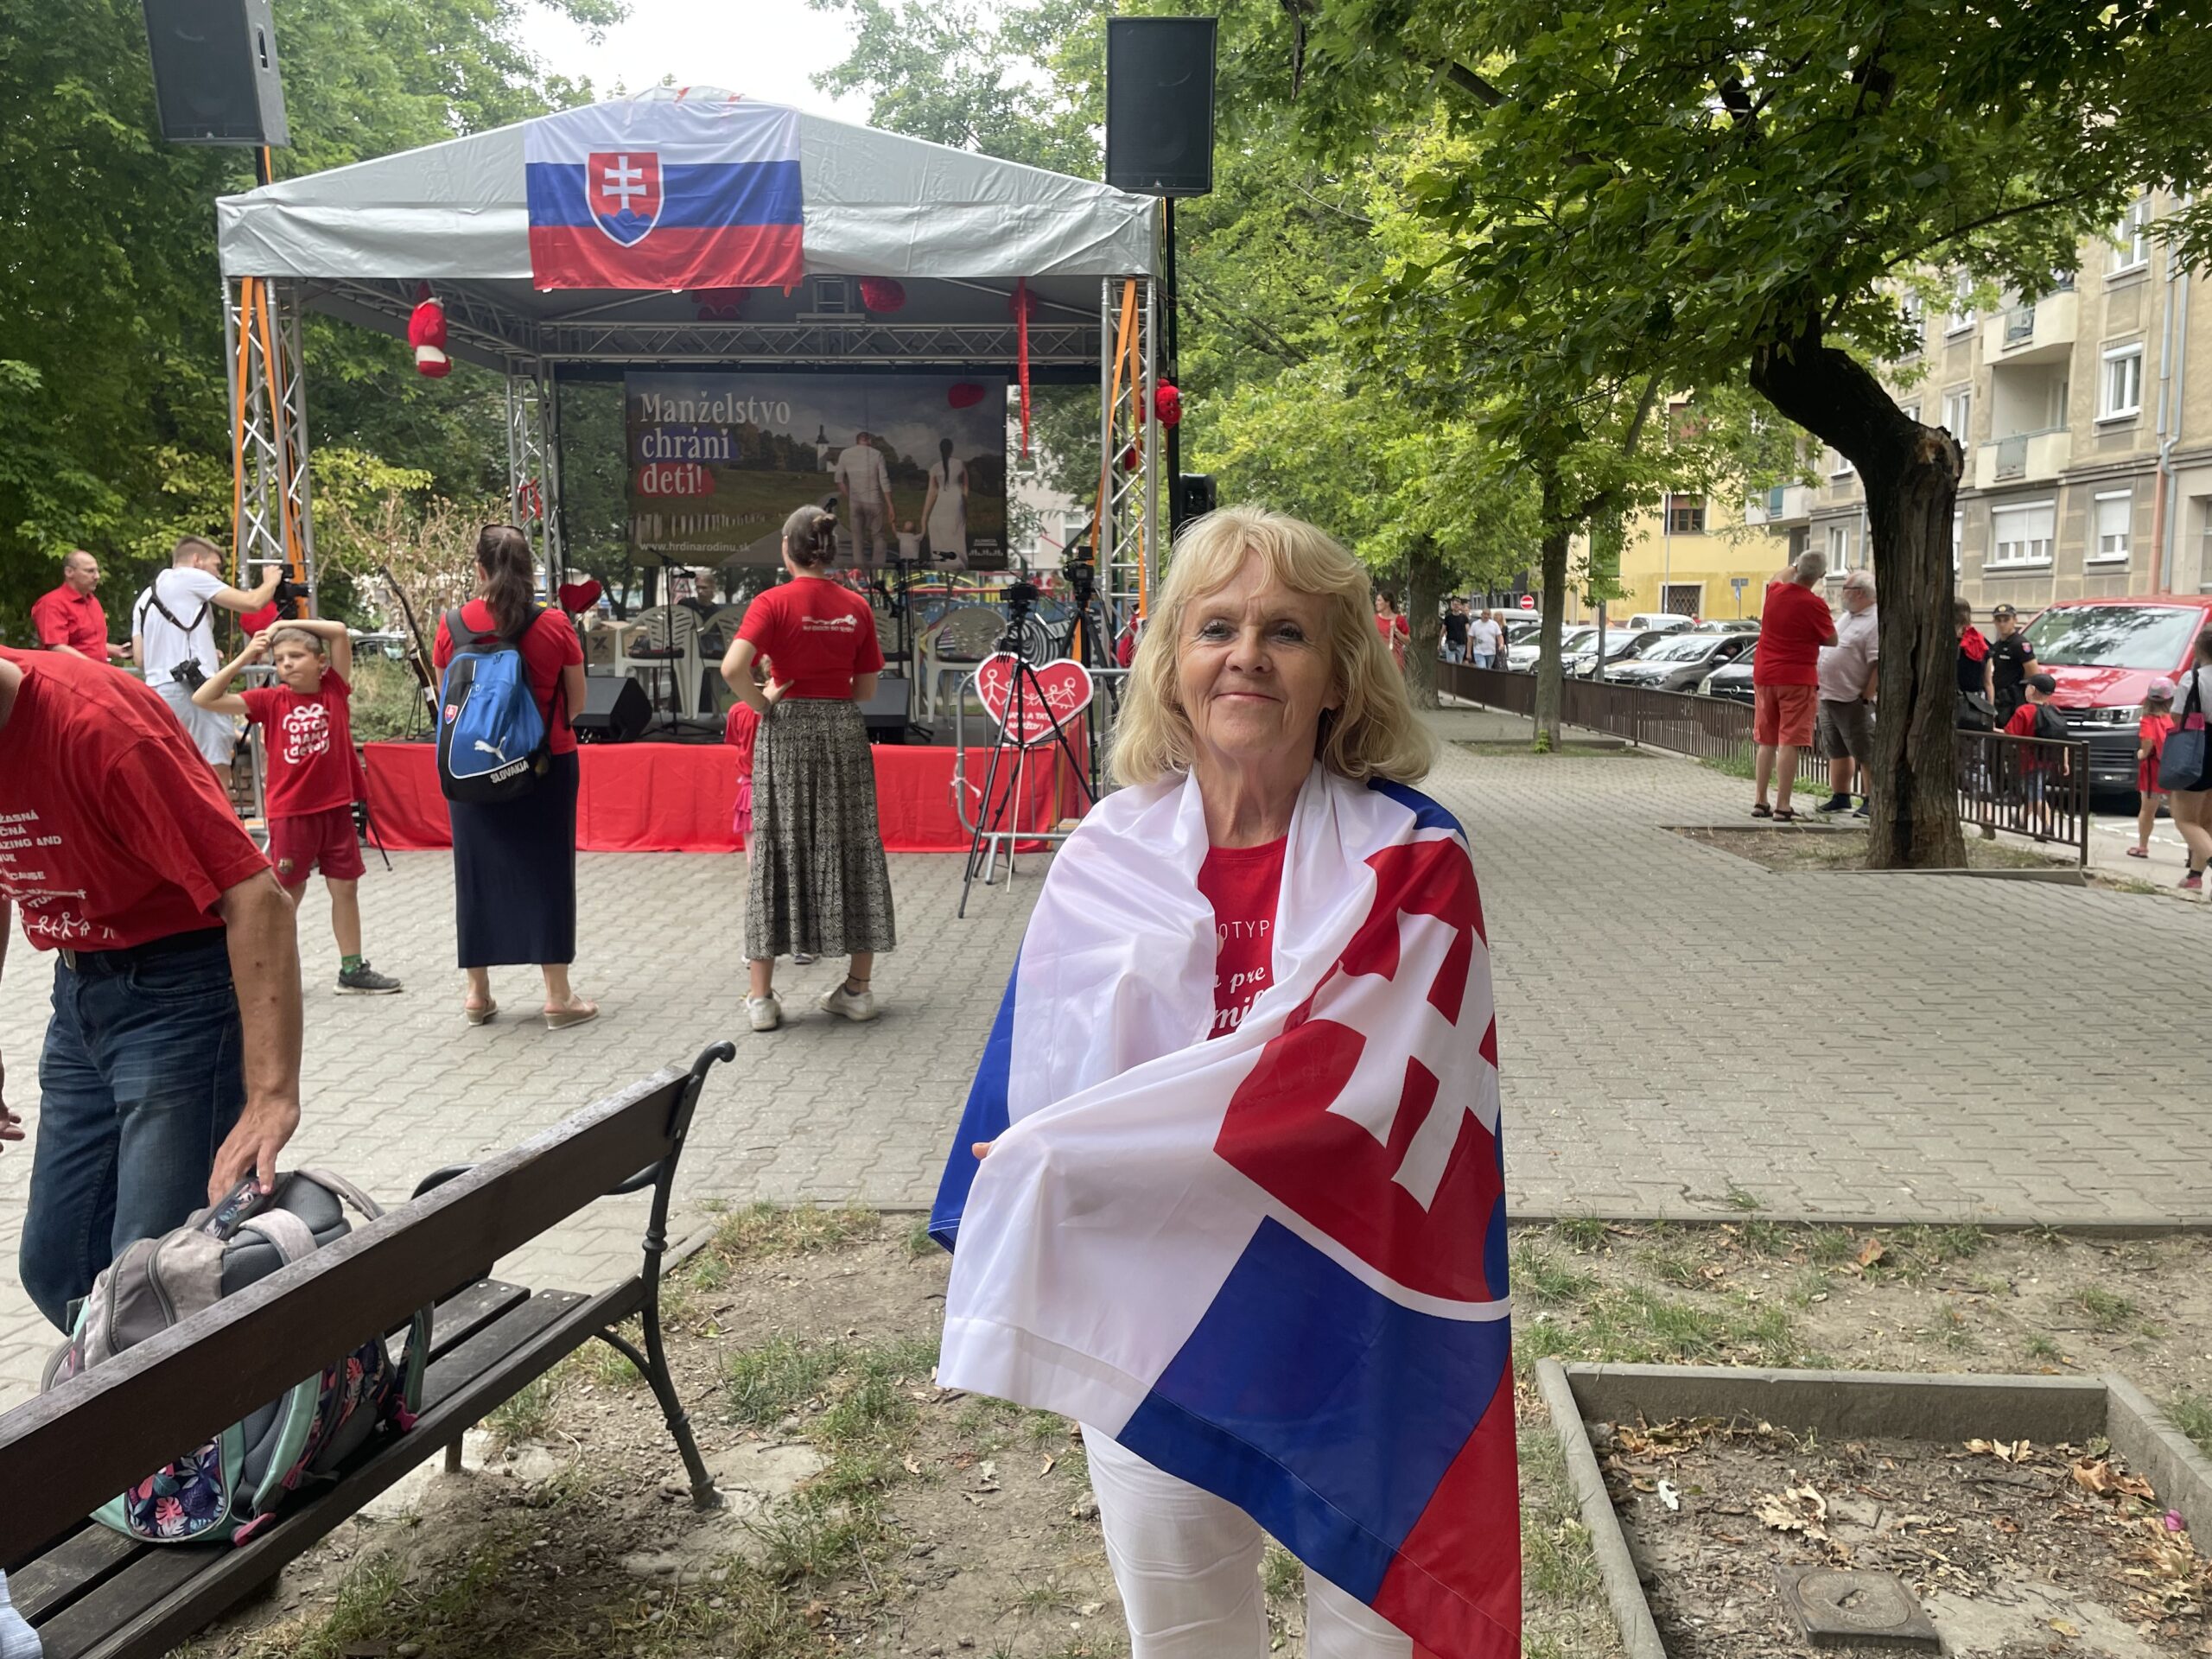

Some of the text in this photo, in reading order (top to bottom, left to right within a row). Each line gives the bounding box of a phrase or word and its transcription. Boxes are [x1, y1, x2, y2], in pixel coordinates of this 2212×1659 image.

[640, 391, 791, 425] Manželstvo
[641, 426, 730, 460] chráni
[642, 463, 702, 494] deti!
[639, 541, 751, 552] www.hrdinarodinu.sk
[490, 760, 530, 784] SLOVAKIA
[1218, 919, 1270, 941] OTYP
[1230, 966, 1266, 994] pre
